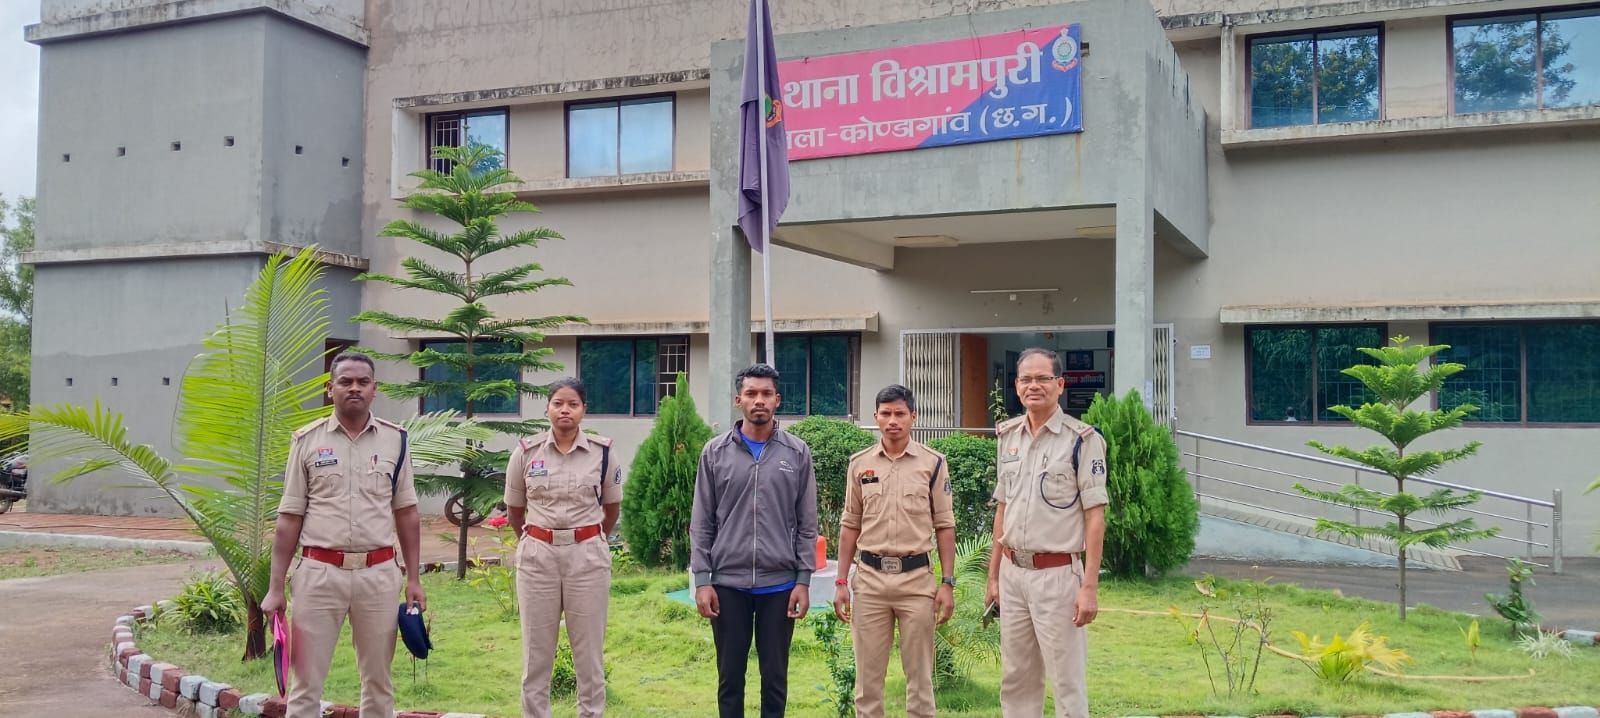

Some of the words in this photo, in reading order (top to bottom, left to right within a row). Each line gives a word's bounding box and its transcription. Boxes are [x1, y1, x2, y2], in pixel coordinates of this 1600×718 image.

[783, 74, 860, 109] थाना
[869, 41, 1044, 102] विश्रामपुरी
[979, 97, 1073, 135] (छ.ग.)
